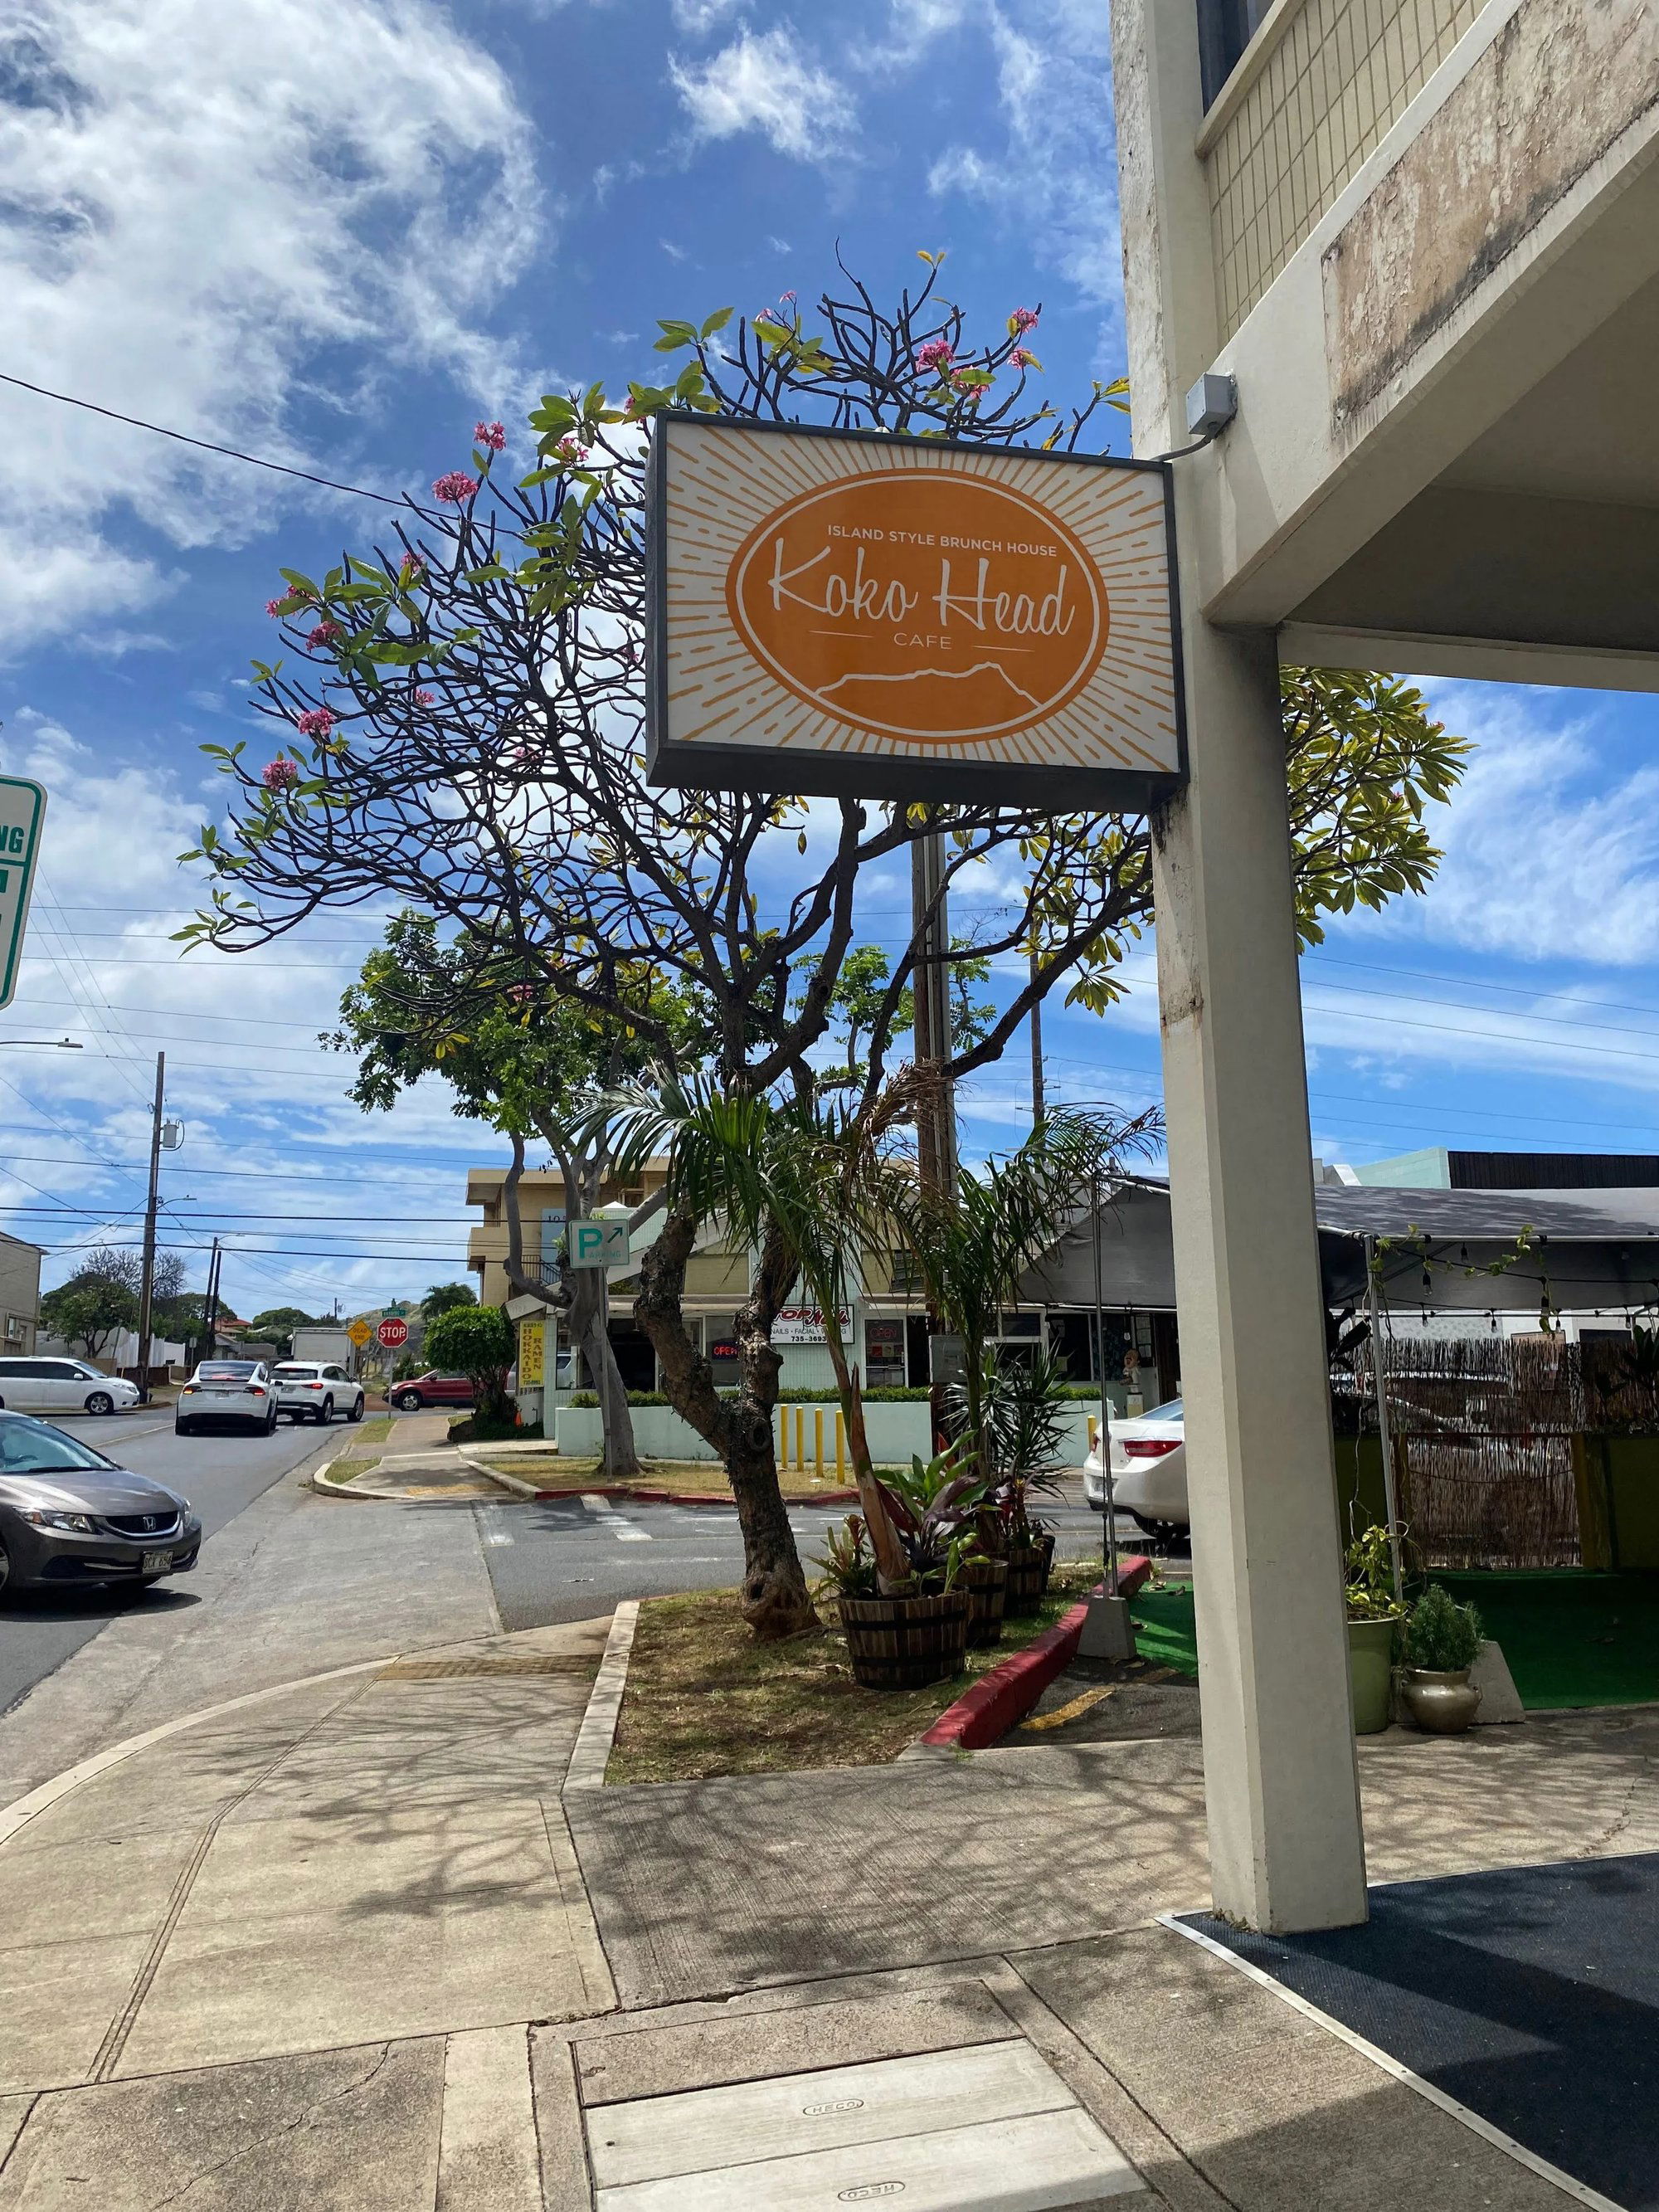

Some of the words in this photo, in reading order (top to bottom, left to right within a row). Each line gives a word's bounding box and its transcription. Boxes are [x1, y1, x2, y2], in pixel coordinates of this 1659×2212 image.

[828, 524, 884, 540] ISLAND
[889, 530, 936, 546] STYLE
[940, 535, 1002, 552] BRUNCH
[1007, 542, 1057, 557] HOUSE
[767, 537, 919, 622] Koko
[932, 557, 1076, 636] Head
[893, 631, 952, 650] CAFE
[379, 1327, 406, 1338] STOP
